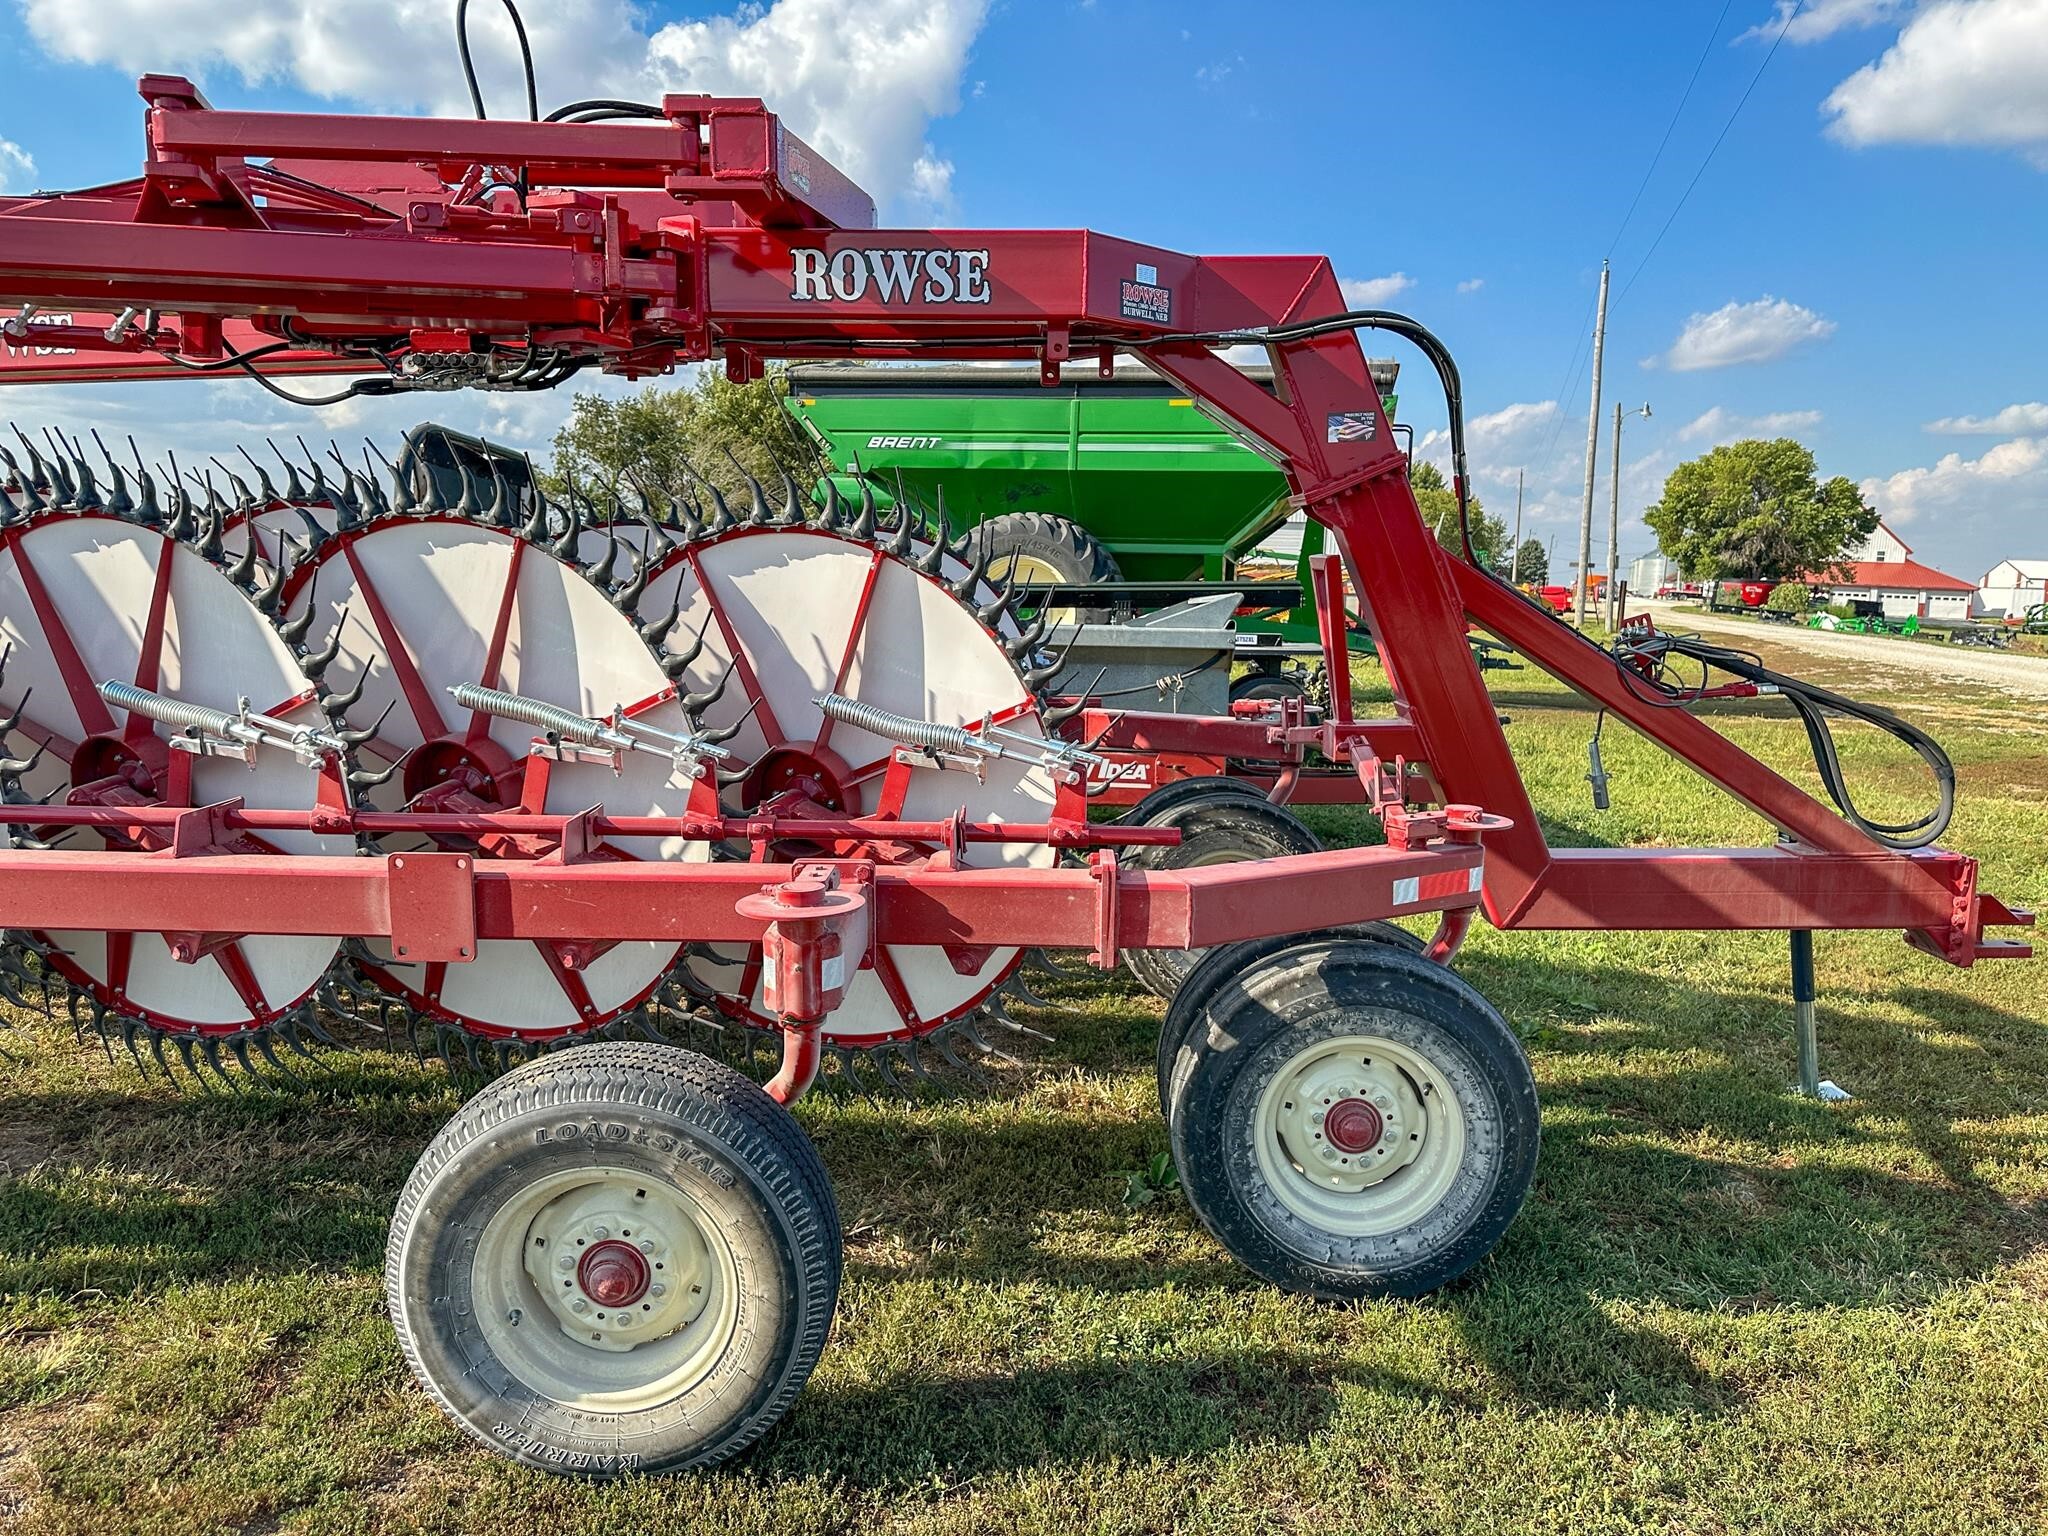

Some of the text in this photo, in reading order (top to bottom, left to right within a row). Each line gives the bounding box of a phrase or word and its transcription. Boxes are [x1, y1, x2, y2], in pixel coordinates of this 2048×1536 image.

[789, 248, 991, 303] ROWSE
[1122, 282, 1169, 307] ROWSE
[1123, 306, 1168, 322] BURWELL, NEB
[867, 436, 943, 449] BRENT
[1098, 758, 1147, 780] IDEA
[535, 1121, 737, 1192] LOAD STAR
[492, 1421, 640, 1468] KARRIER
